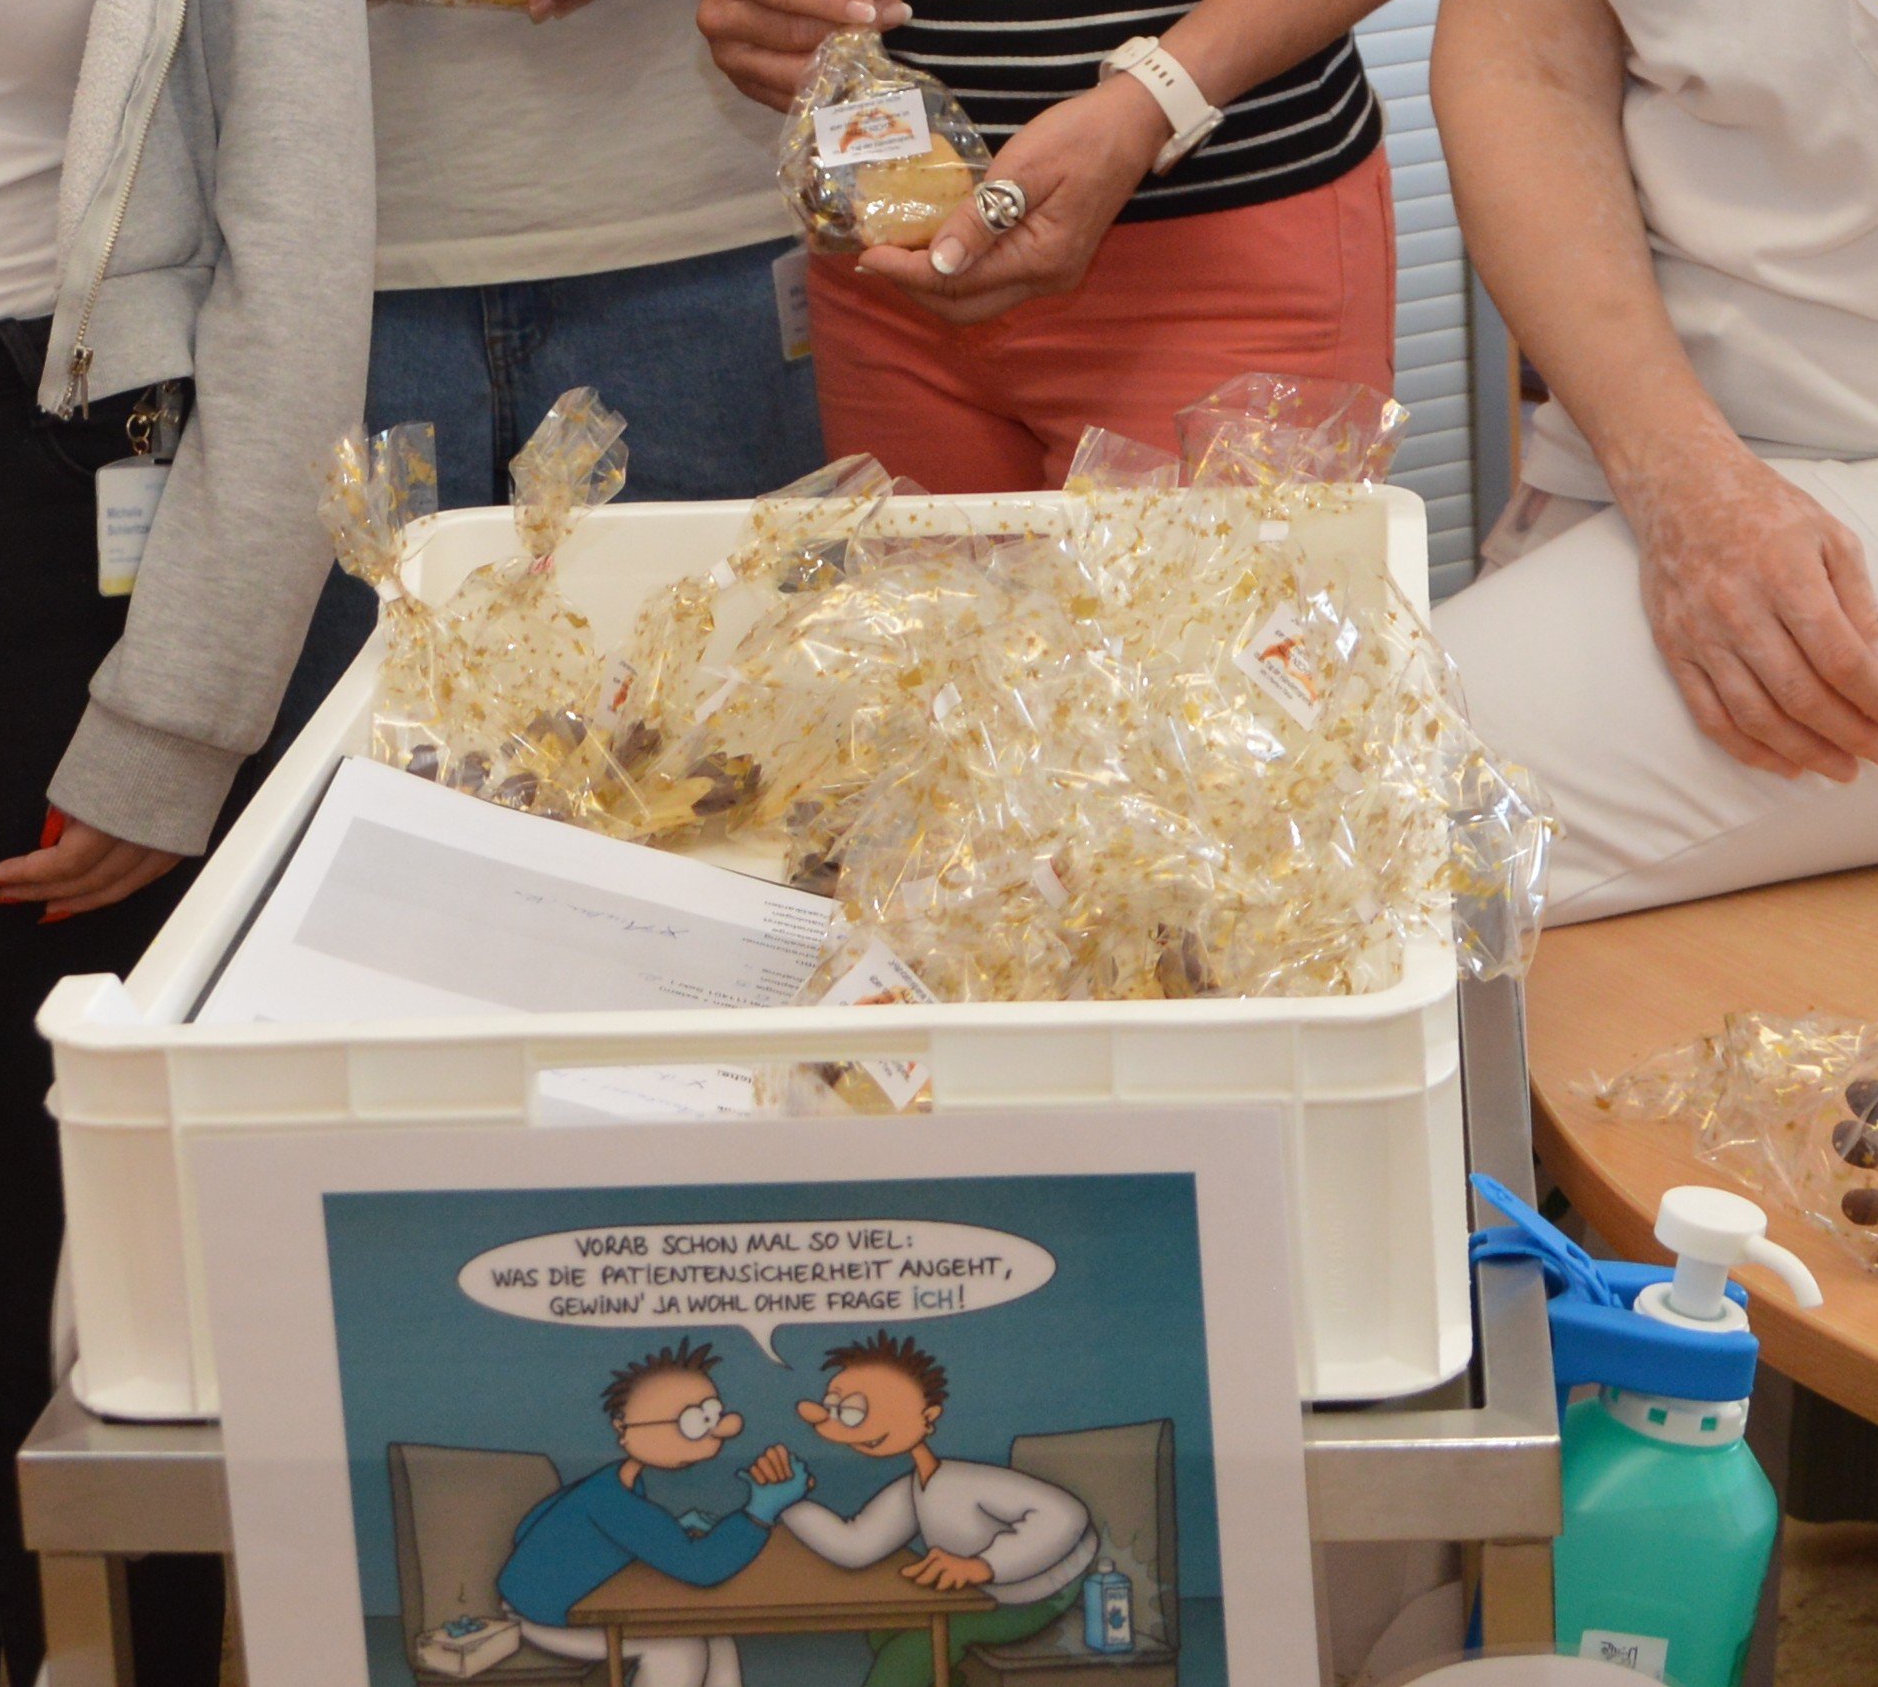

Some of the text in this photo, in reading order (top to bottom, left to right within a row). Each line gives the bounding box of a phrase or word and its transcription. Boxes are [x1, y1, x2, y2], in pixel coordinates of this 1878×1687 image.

[575, 1236, 648, 1257] VORAB
[663, 1235, 738, 1255] SCHON
[746, 1232, 800, 1253] MAL
[808, 1232, 840, 1251] SO
[492, 1267, 539, 1287] WAS
[899, 1257, 1012, 1280] ANGEHT,
[653, 1294, 680, 1313] JA
[688, 1294, 748, 1312] WOHL
[754, 1293, 816, 1311] OHNE
[827, 1291, 902, 1310] FRAGE
